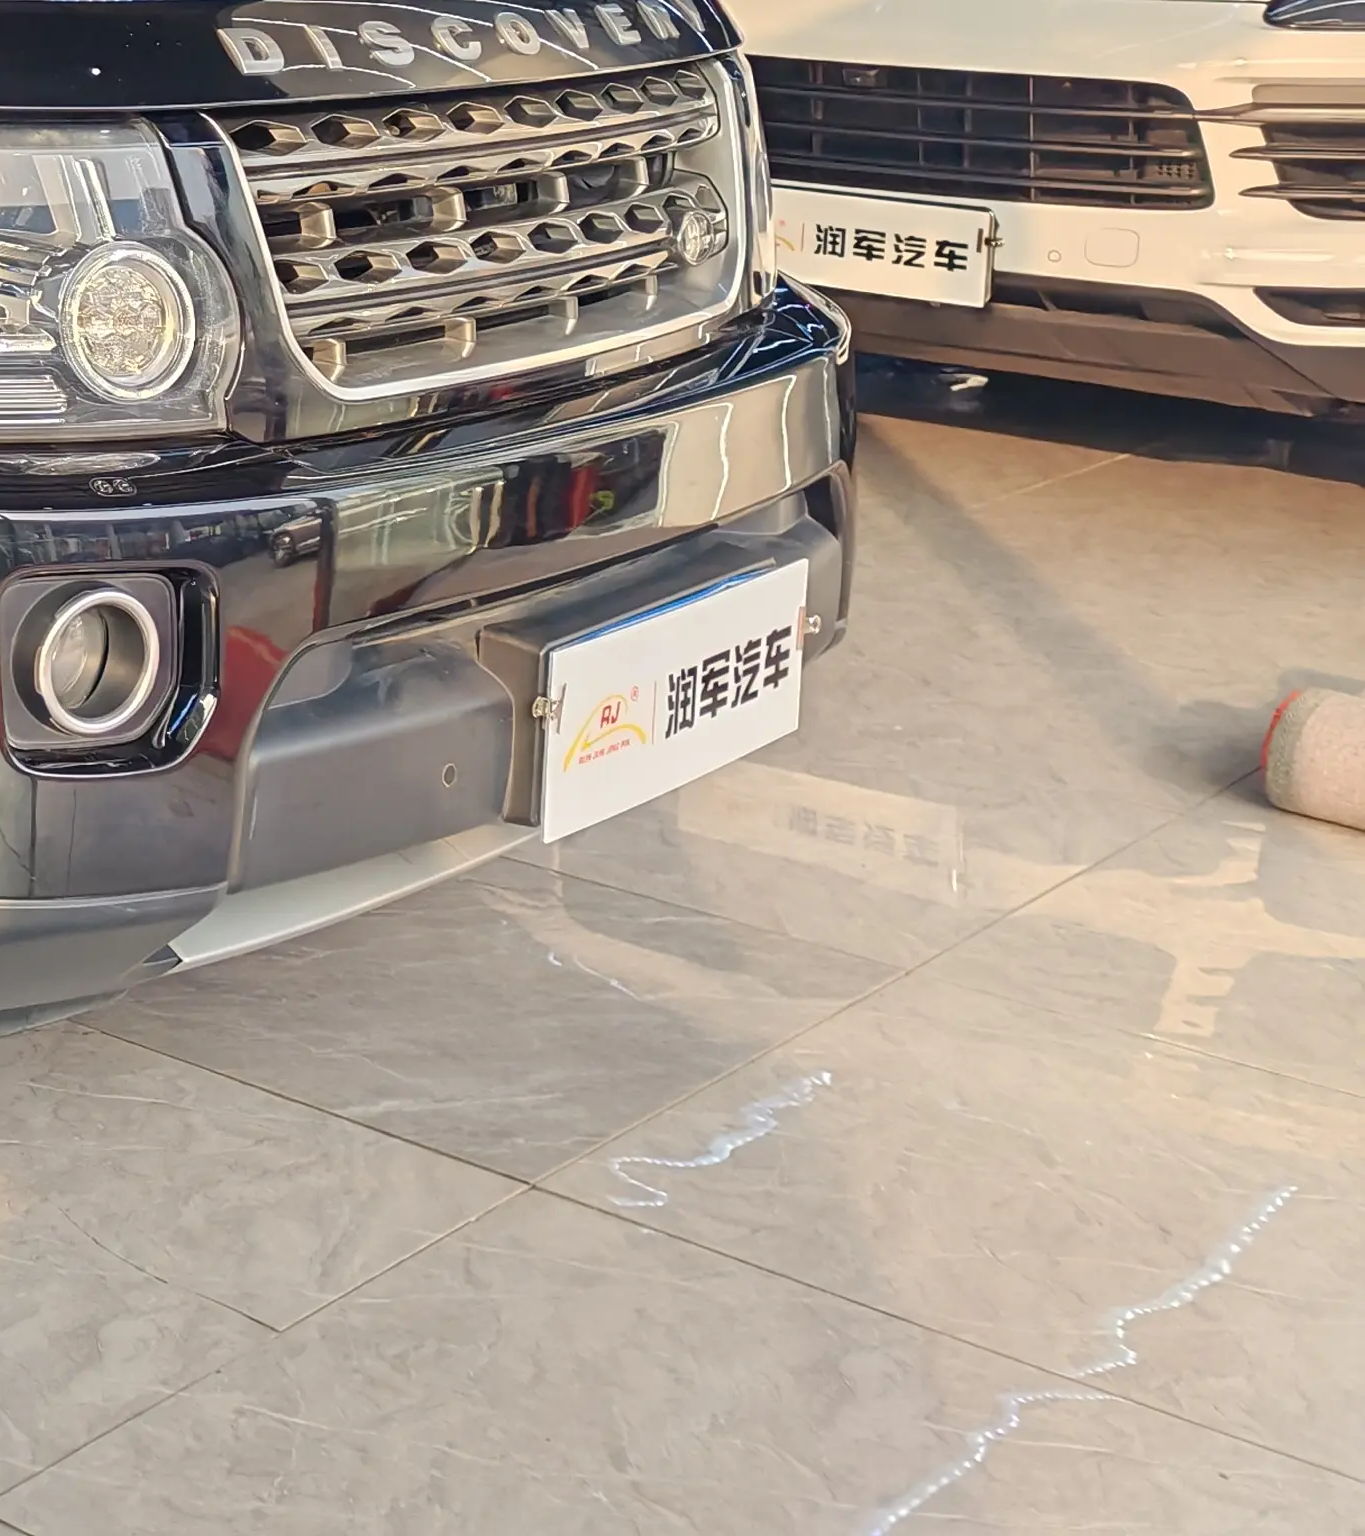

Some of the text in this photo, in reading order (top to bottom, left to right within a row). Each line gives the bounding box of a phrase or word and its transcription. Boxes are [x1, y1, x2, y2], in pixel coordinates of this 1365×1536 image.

[814, 224, 969, 272] 润军汽车
[665, 626, 792, 739] 润军汽车
